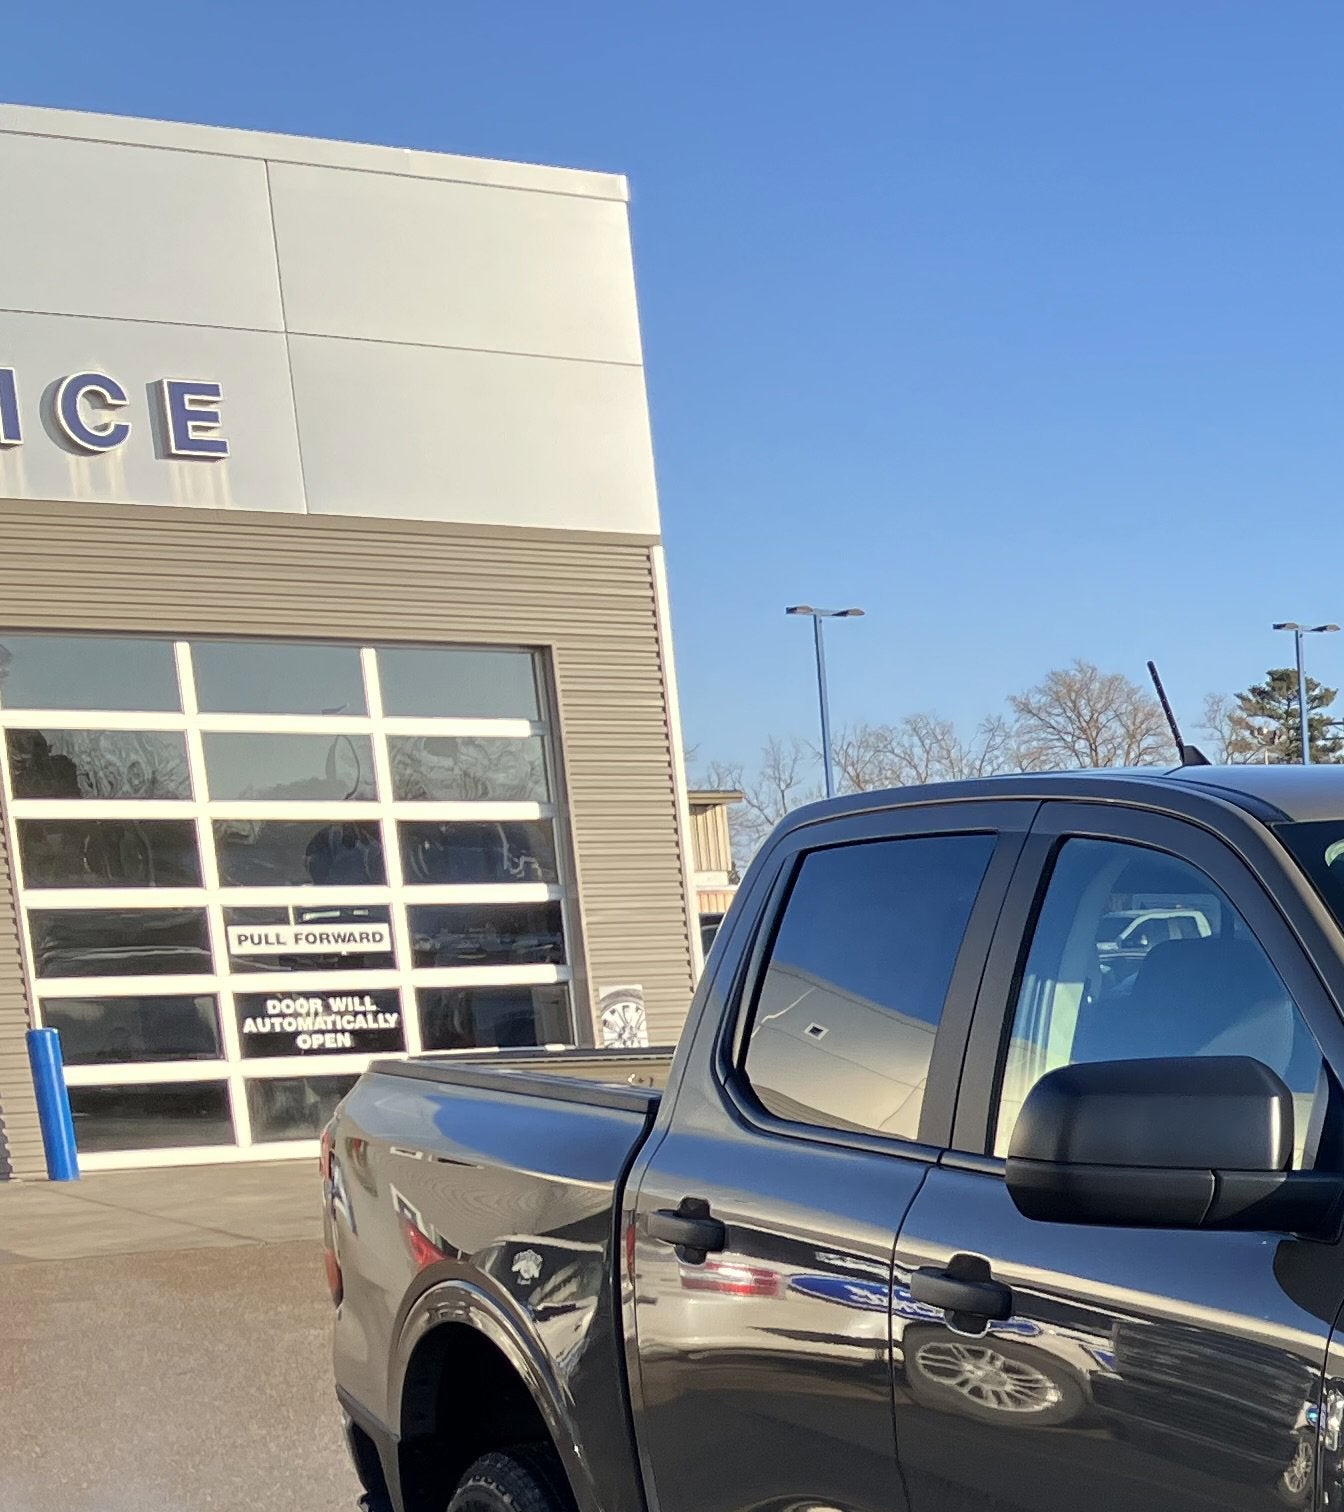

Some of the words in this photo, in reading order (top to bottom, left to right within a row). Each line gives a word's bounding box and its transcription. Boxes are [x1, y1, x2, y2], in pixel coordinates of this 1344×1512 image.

[237, 933, 286, 946] PULL
[294, 931, 384, 945] FORWARD
[266, 998, 323, 1015] DOOR
[328, 995, 377, 1012] WILL
[243, 1012, 399, 1034] AUTOMATICALLY
[295, 1032, 352, 1050] OPEN
